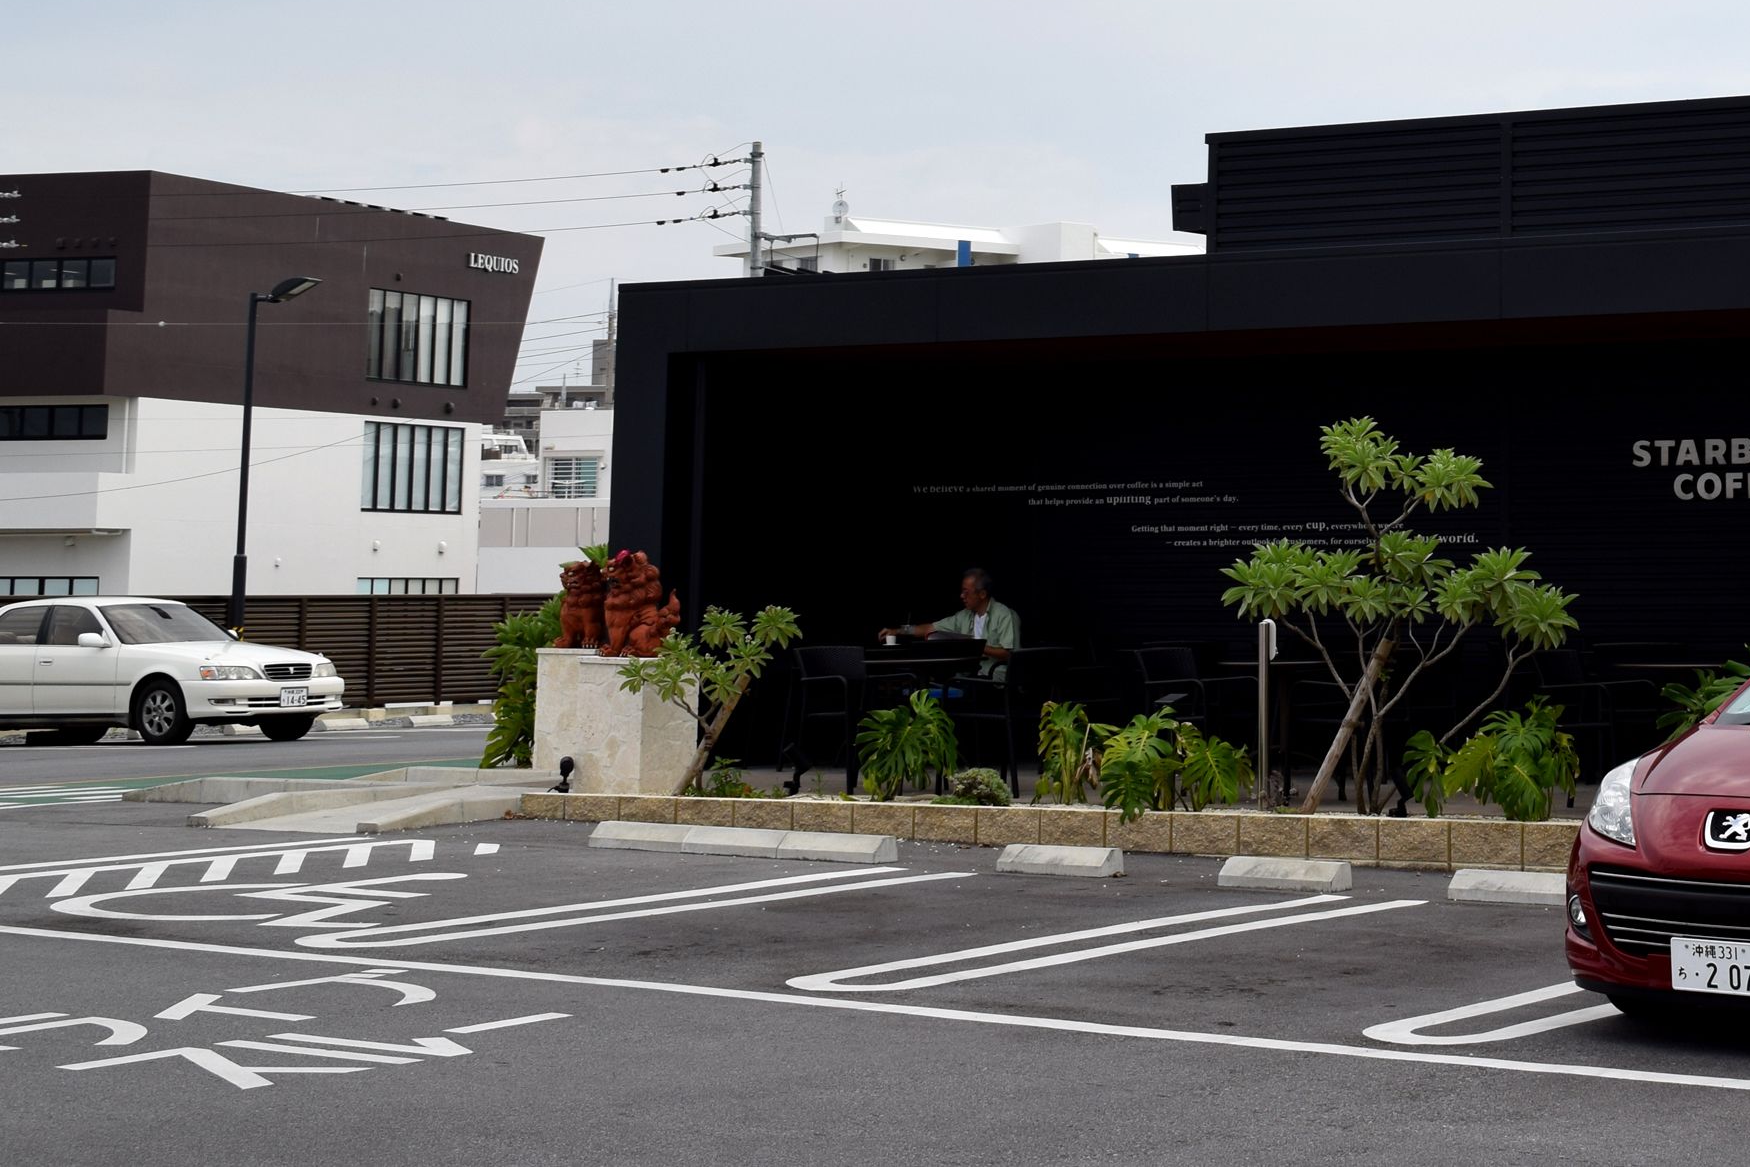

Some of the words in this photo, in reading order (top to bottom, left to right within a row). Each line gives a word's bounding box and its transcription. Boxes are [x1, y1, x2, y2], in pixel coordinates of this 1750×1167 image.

[469, 253, 519, 274] LEQUIOS
[912, 485, 928, 494] We
[929, 484, 964, 494] believe
[972, 484, 996, 493] shared
[997, 484, 1026, 492] moment
[1027, 483, 1036, 491] of
[1037, 483, 1065, 493] genuine
[1066, 481, 1107, 490] connection
[1127, 481, 1149, 489] coffee
[1150, 481, 1157, 489] is
[1164, 480, 1190, 490] simple
[1191, 480, 1203, 488] act
[1028, 497, 1043, 506] that
[1044, 497, 1064, 507] helps
[1065, 497, 1093, 507] provide
[1106, 495, 1151, 506] uplifting
[1154, 496, 1170, 505] part
[1171, 495, 1180, 503] of
[1181, 494, 1221, 503] someone's
[1222, 494, 1239, 504] day.
[1131, 524, 1159, 534] Getting
[1160, 524, 1175, 532] that
[1176, 524, 1208, 532] moment
[1209, 523, 1228, 533] right
[1238, 524, 1259, 533] every
[1260, 523, 1281, 532] time,
[1282, 524, 1303, 533] every
[1305, 521, 1329, 532] cup,
[1173, 539, 1201, 547] creates
[1208, 538, 1240, 549] brighter
[1330, 537, 1342, 545] for
[1437, 533, 1479, 543] world.
[0, 969, 437, 1047] ライブ
[55, 1012, 574, 1090] スルー
